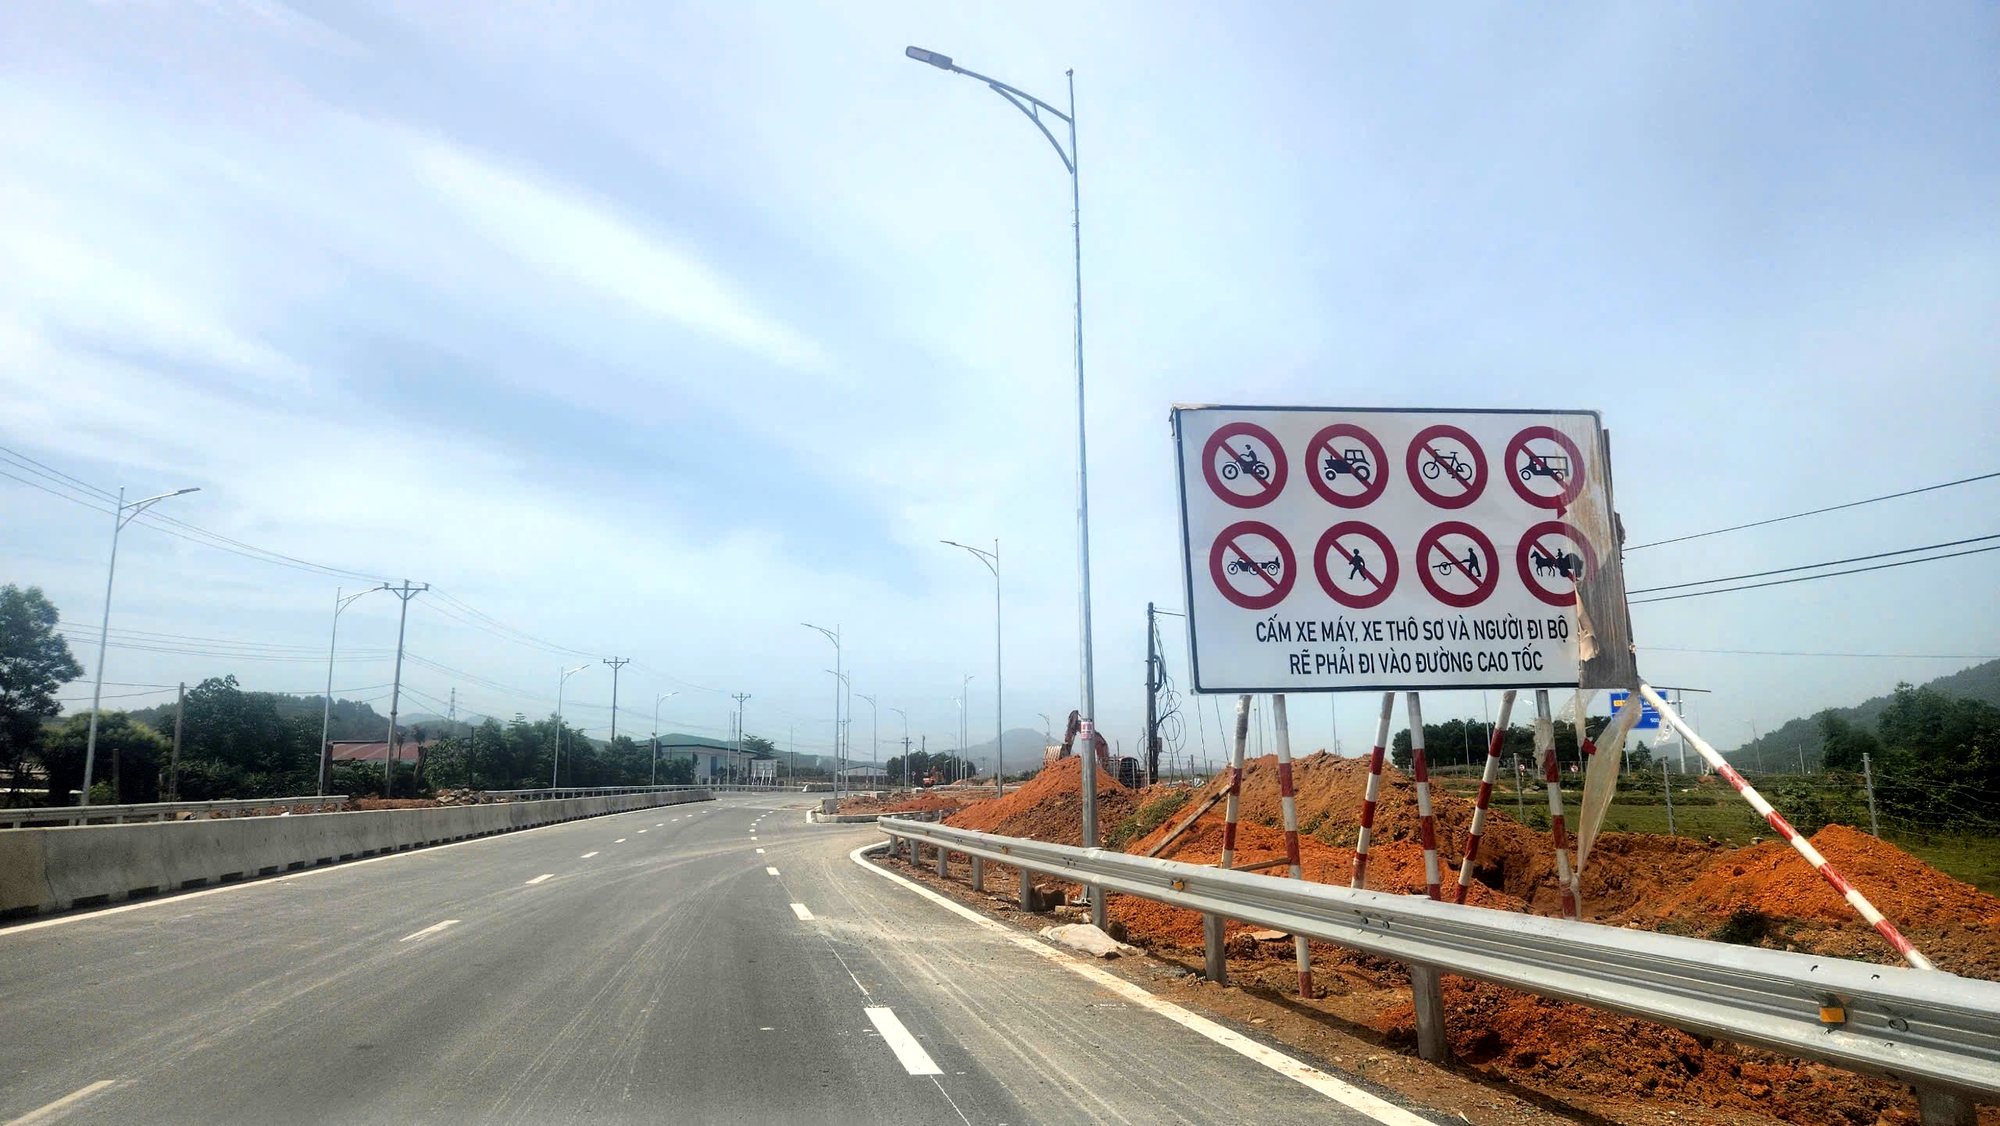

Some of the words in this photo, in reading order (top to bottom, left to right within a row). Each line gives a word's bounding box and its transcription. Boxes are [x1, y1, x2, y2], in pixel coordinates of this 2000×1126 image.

[1256, 613, 1291, 642] CẤM
[1296, 621, 1317, 642] XE
[1321, 616, 1358, 643] MÁY,
[1363, 621, 1383, 641] XE
[1386, 616, 1418, 641] THÔ
[1423, 619, 1445, 641] SƠ
[1447, 614, 1470, 640] VÀ
[1474, 612, 1524, 640] NGƯỜI
[1527, 619, 1543, 639] ĐI
[1547, 615, 1569, 643] BỘ
[1290, 649, 1312, 675] RẼ
[1316, 646, 1355, 675] PHẢI
[1358, 653, 1375, 674] ĐI
[1378, 647, 1412, 674] VÀO
[1415, 646, 1473, 673] ĐƯỜNG
[1477, 651, 1509, 672] CAO
[1511, 643, 1544, 671] TỐC
